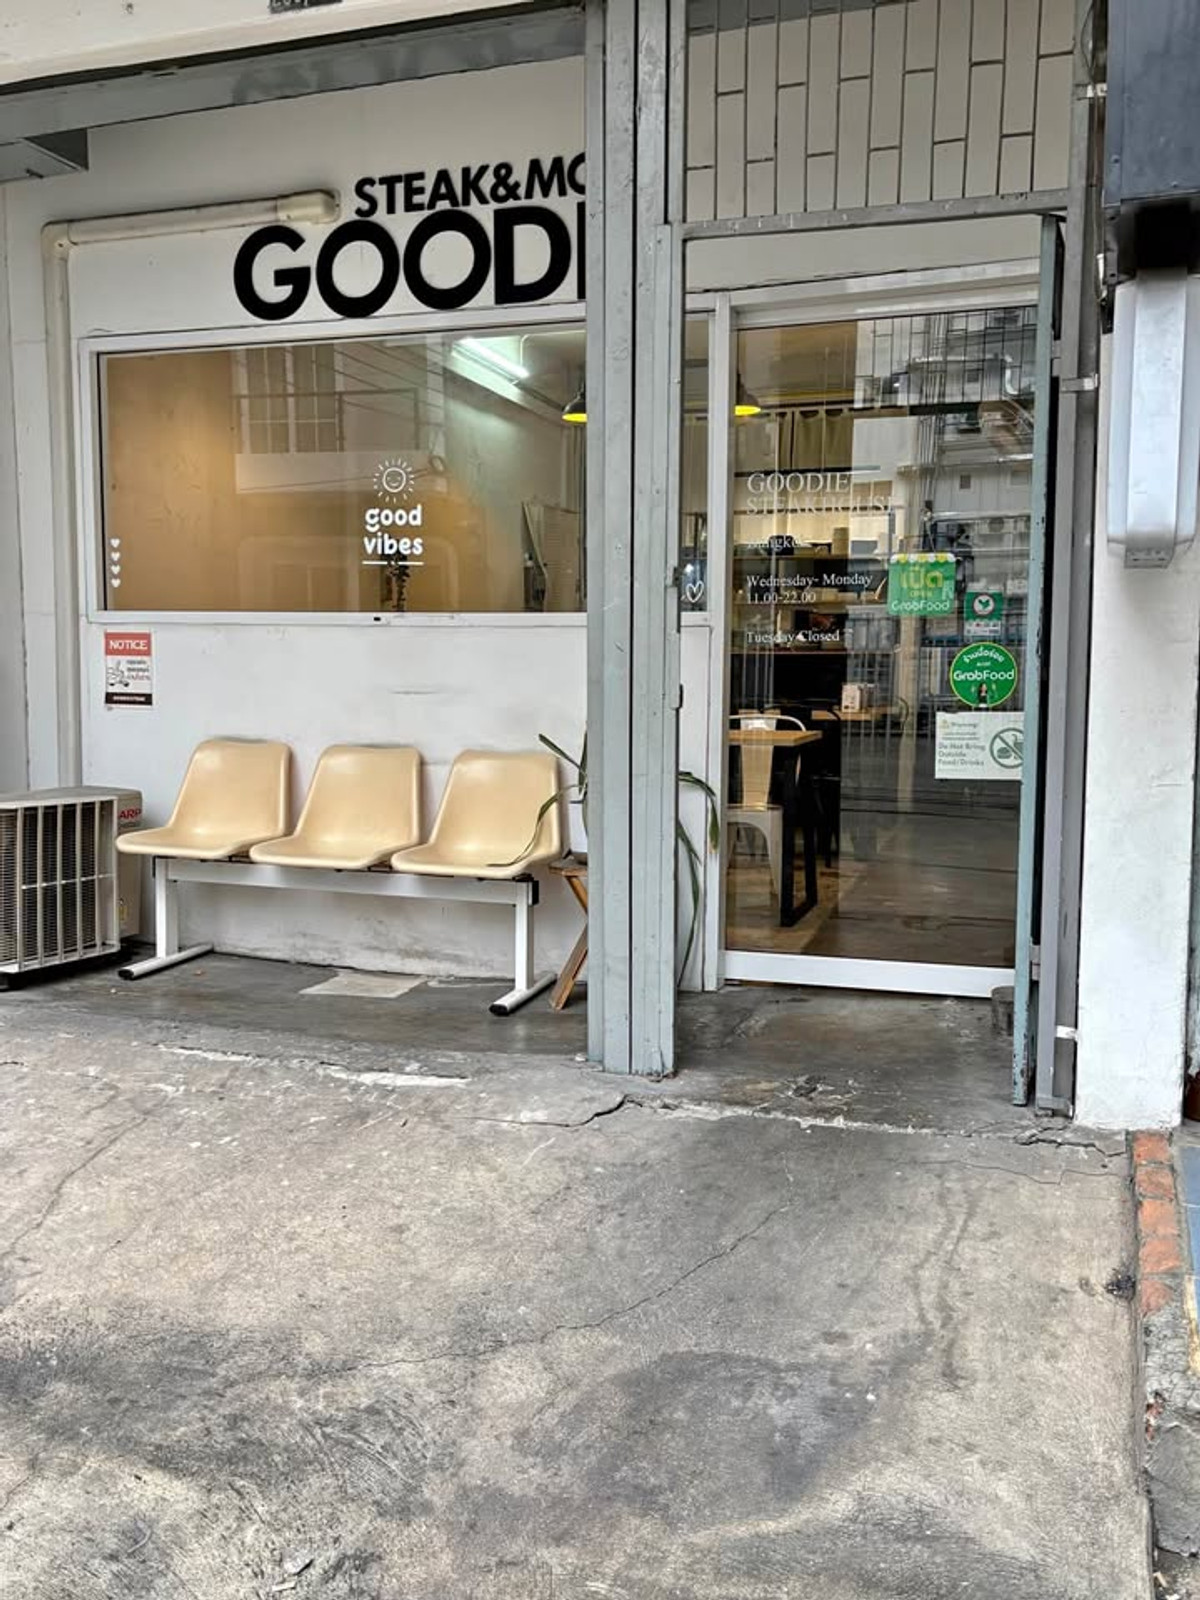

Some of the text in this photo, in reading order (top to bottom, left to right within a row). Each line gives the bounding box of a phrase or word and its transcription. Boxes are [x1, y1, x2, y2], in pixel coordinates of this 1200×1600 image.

[747, 472, 851, 493] GOODIE
[365, 504, 422, 533] good
[363, 532, 424, 555] vibes
[822, 573, 873, 588] Monday
[746, 591, 817, 604] 11.00-22.00
[891, 600, 950, 611] GrabFood
[747, 629, 840, 645] Tuesday Closed
[109, 640, 148, 650] NOTICE
[953, 669, 1015, 681] GrabFood
